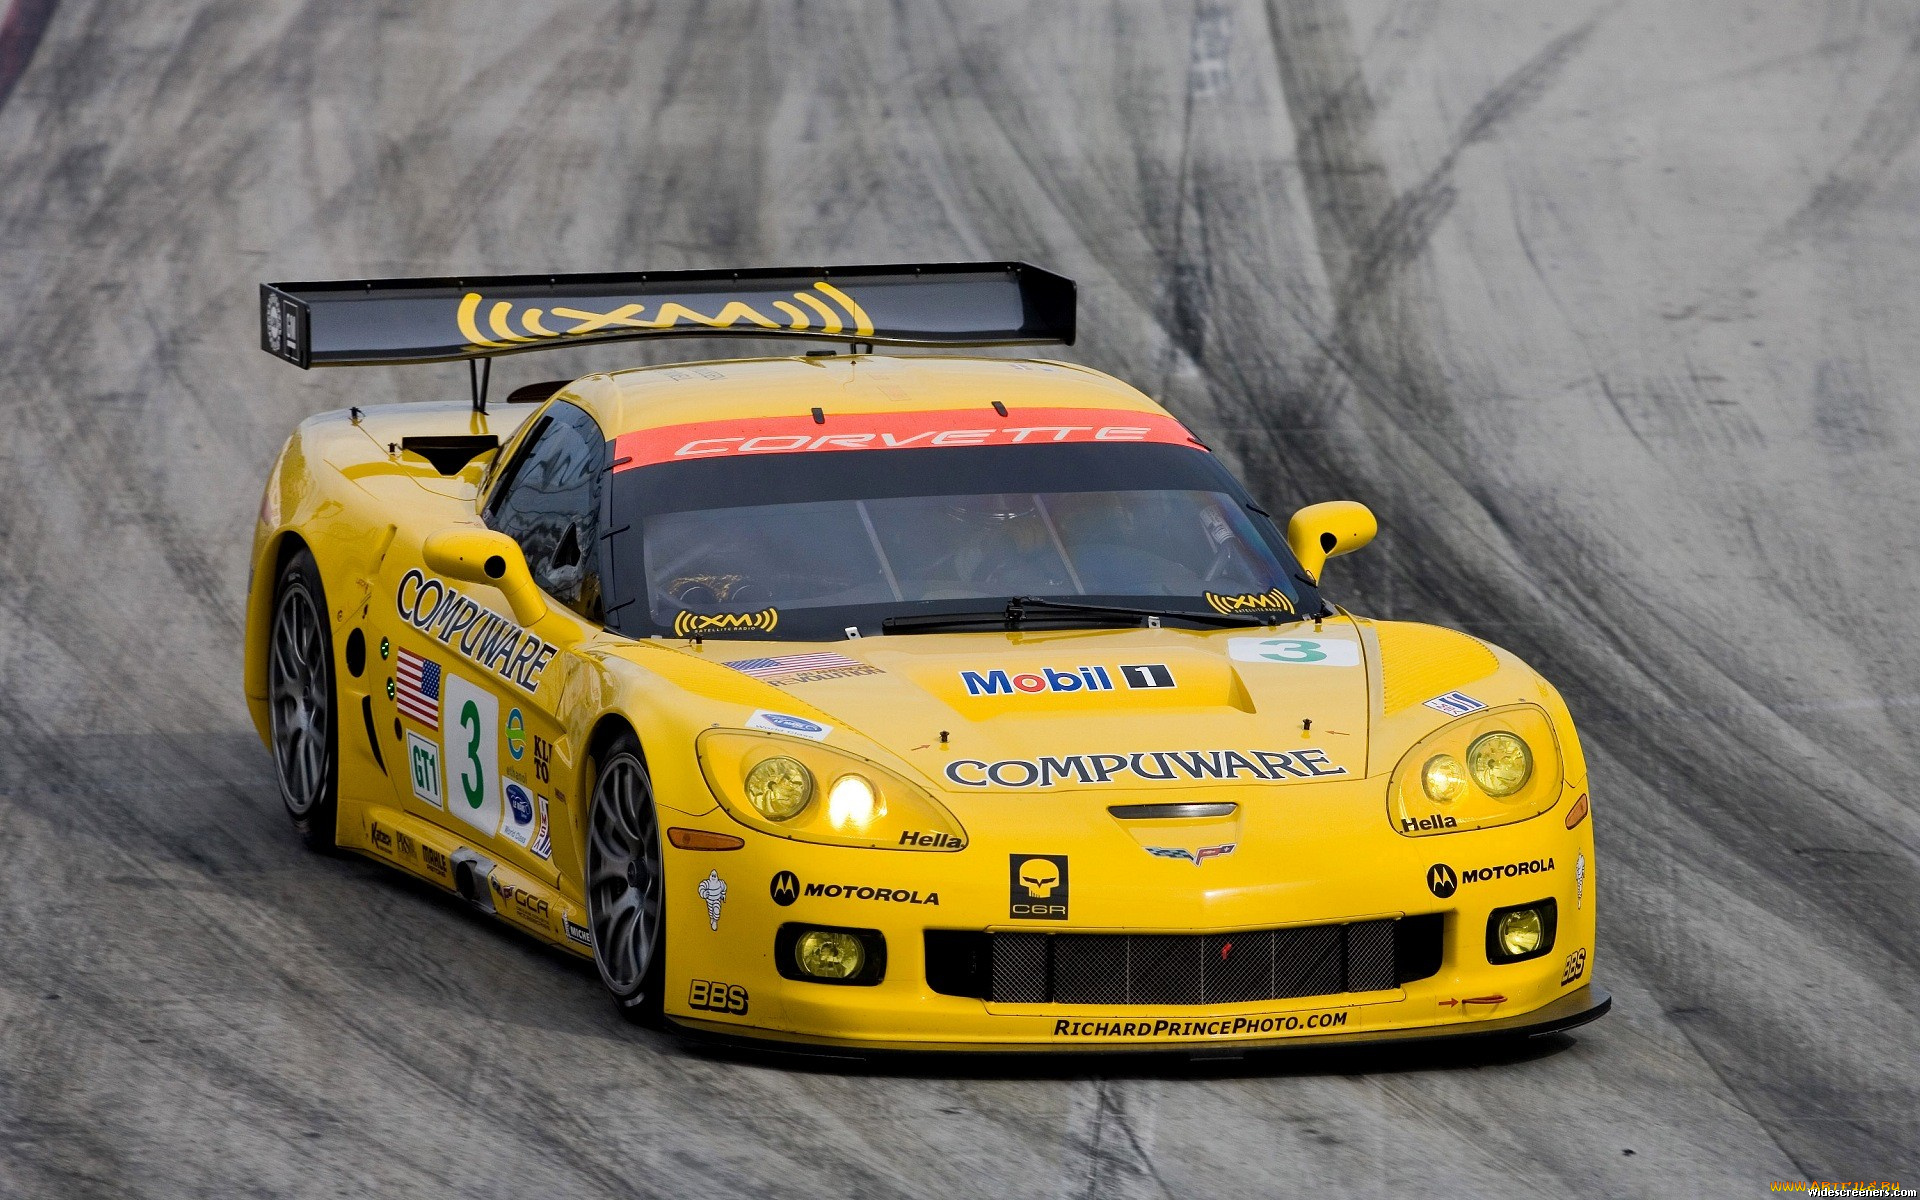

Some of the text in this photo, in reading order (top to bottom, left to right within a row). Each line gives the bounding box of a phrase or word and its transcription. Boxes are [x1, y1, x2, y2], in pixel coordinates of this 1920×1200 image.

[673, 425, 1152, 456] CORVETTE
[397, 568, 559, 694] COMPUWARE
[694, 626, 731, 634] SATELLITE
[1259, 639, 1328, 663] 3
[961, 665, 1113, 695] Mobil
[460, 699, 485, 809] 3
[945, 749, 1348, 789] COMPUWARE
[412, 744, 438, 796] GT1
[1401, 814, 1457, 833] Hella
[898, 830, 962, 849] Hella
[1462, 857, 1556, 884] MOTOROLA
[804, 882, 940, 906] MOTOROLA
[1012, 903, 1067, 916] C6R
[1561, 947, 1587, 986] BBS
[688, 979, 749, 1016] BBS
